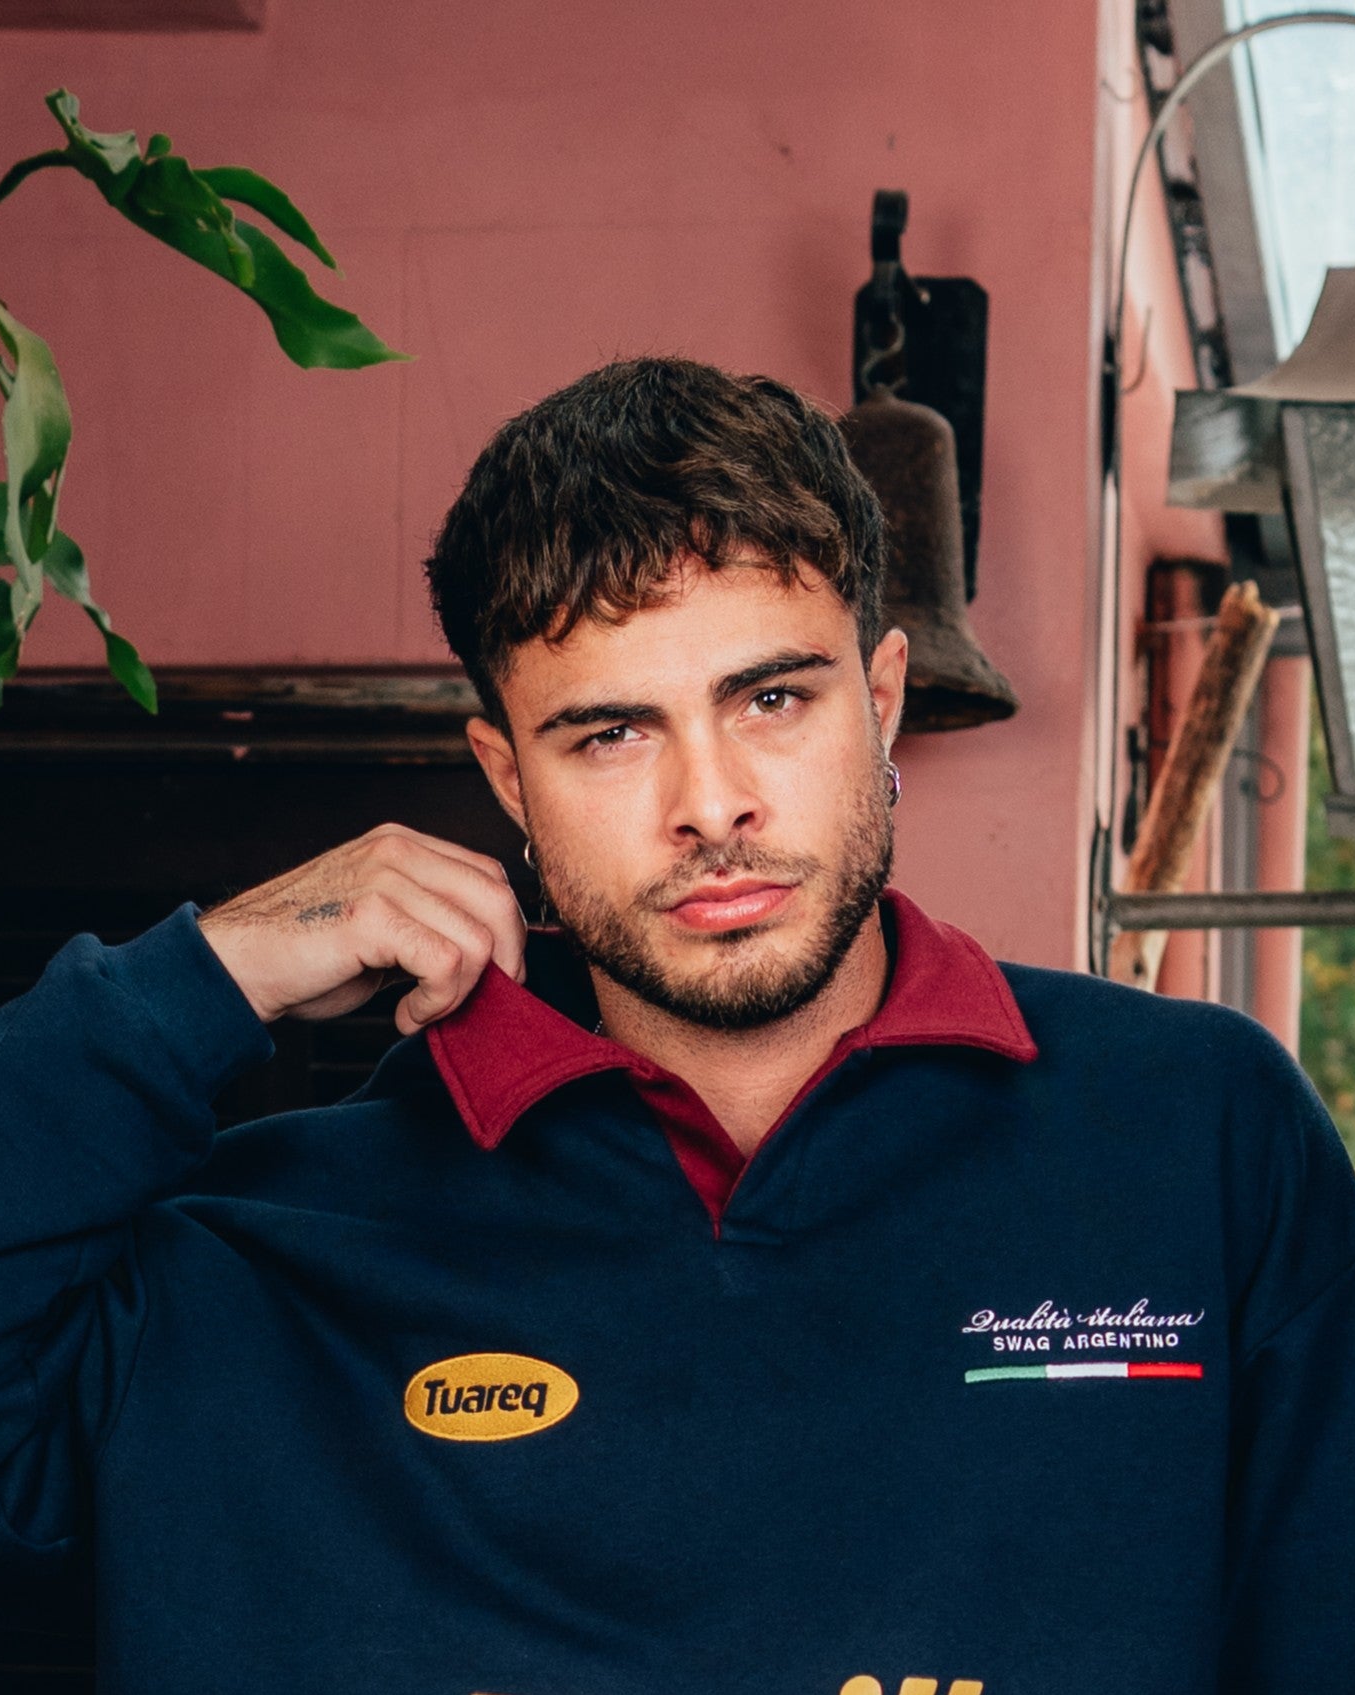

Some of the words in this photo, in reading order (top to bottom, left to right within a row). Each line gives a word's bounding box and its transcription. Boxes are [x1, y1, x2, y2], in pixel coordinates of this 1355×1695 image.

[962, 1300, 1073, 1333] Qualità
[1076, 1297, 1205, 1328] italiana
[993, 1335, 1050, 1352] SWAG
[1063, 1331, 1179, 1351] ARGENTINO
